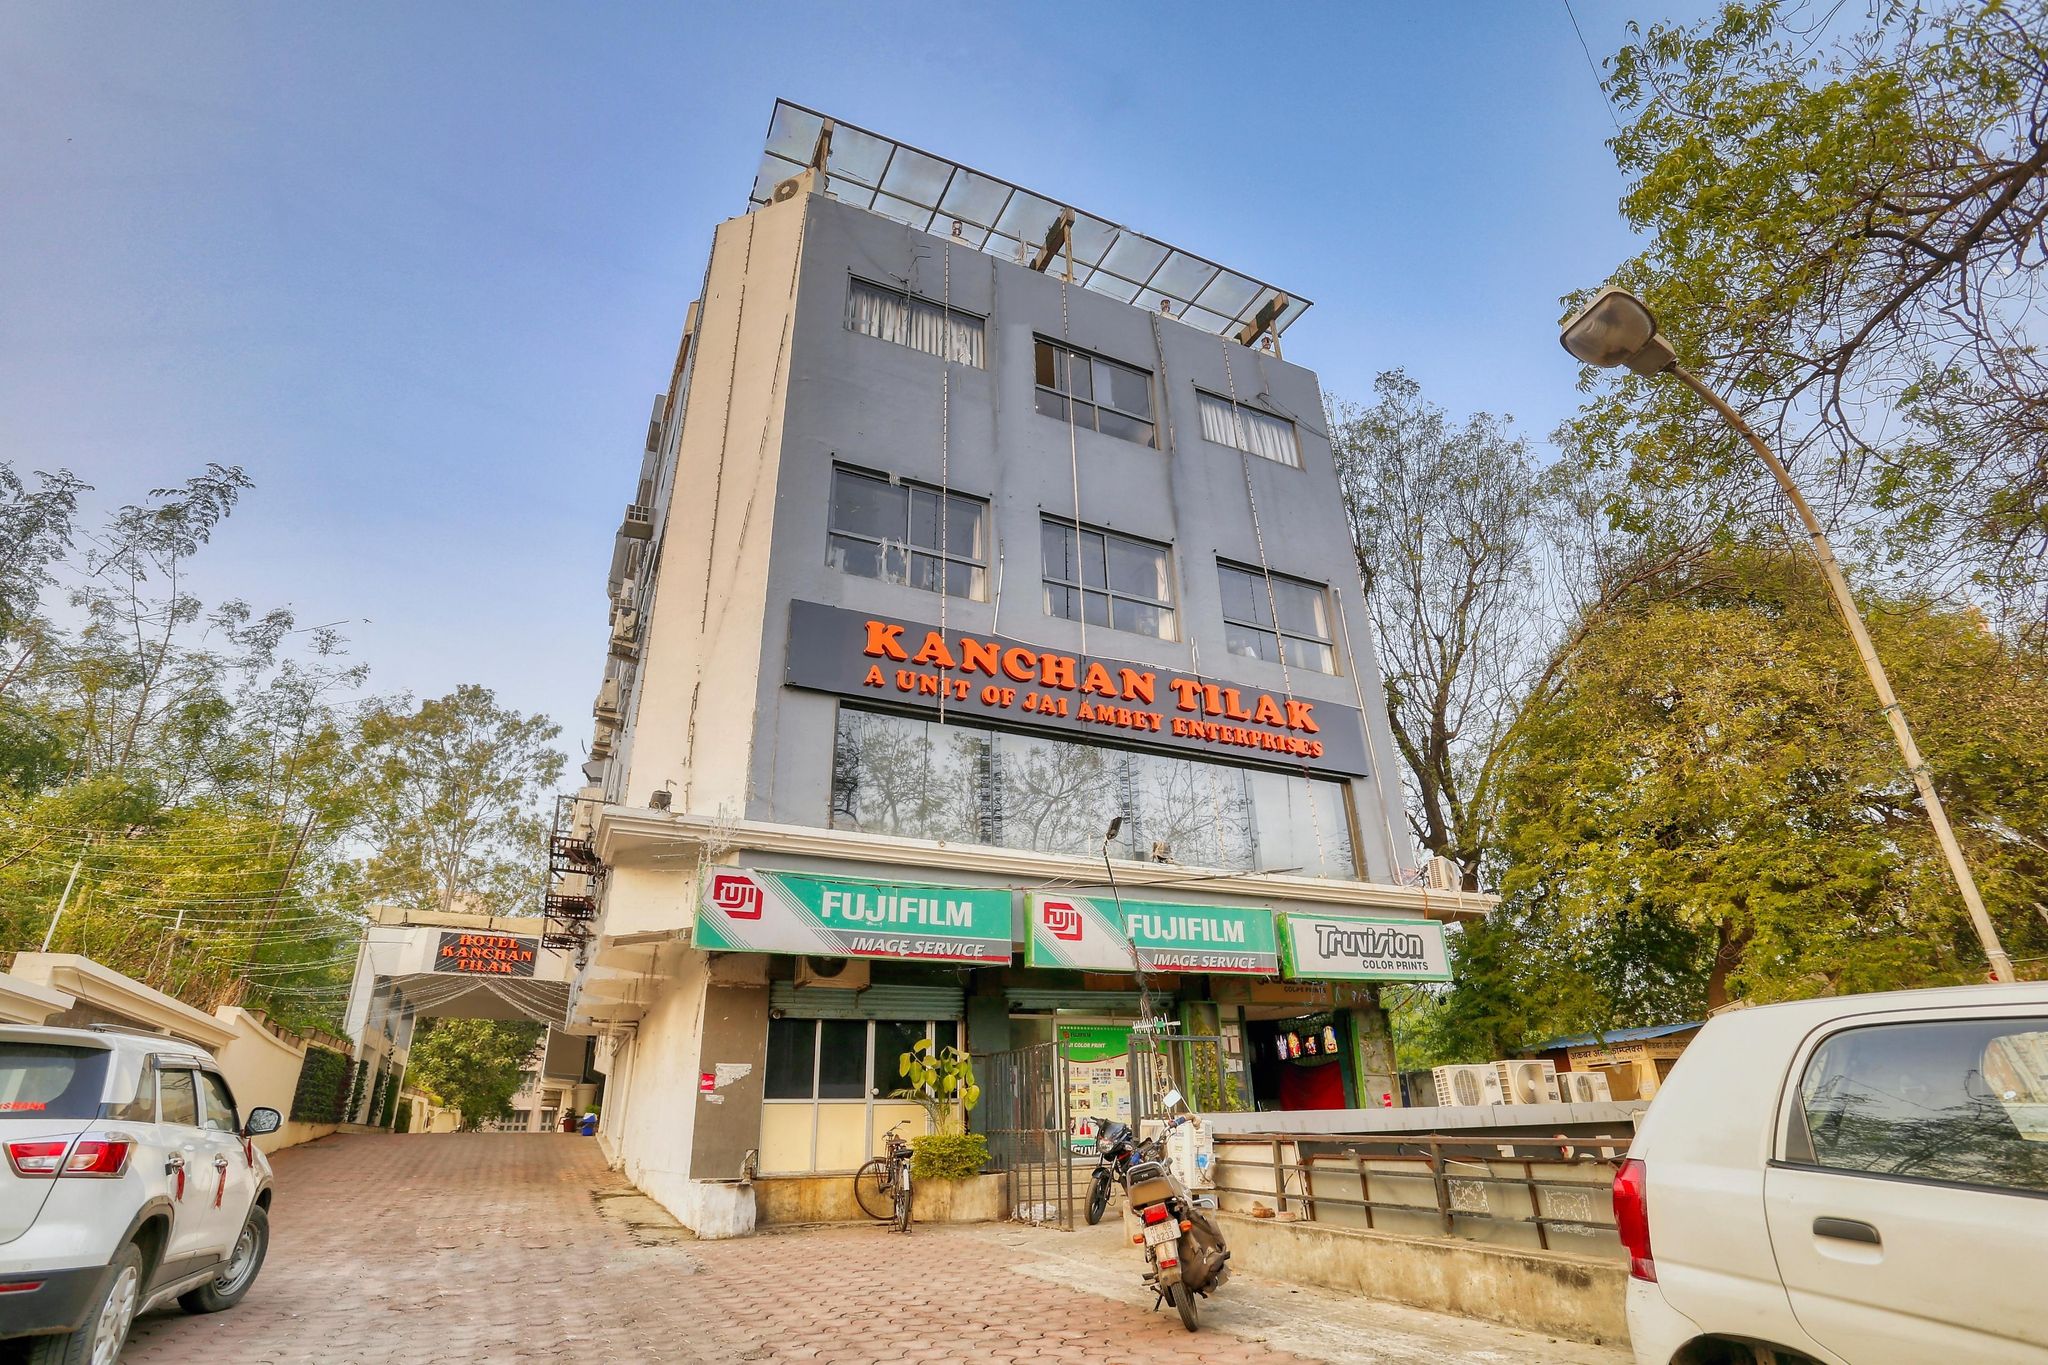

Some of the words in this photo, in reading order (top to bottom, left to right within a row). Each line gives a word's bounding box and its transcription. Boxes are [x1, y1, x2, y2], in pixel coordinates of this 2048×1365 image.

[864, 620, 1157, 705] KANCHAN
[1169, 677, 1320, 734] TILAK
[864, 664, 886, 688] A
[896, 669, 971, 700] UNIT
[981, 685, 1016, 708] OF
[1022, 692, 1069, 718] JAI
[1077, 700, 1164, 733] AMBEY
[1172, 717, 1324, 759] ENTERPRISES
[716, 878, 760, 916] FUJI
[821, 891, 973, 928] FUJIFILM
[1045, 905, 1079, 937] FUJI
[1127, 914, 1245, 943] FUJIFILM
[441, 945, 533, 962] KANCHAN
[459, 934, 519, 950] HOTEL
[851, 937, 910, 953] IMAGE
[913, 940, 985, 957] SERVICE
[1315, 924, 1424, 959] Truvision
[457, 959, 513, 973] TILAK
[1153, 954, 1198, 967] IMAGE
[1201, 955, 1256, 969] SERVICE
[1362, 960, 1394, 970] COLOR
[1396, 961, 1429, 971] PRINTS
